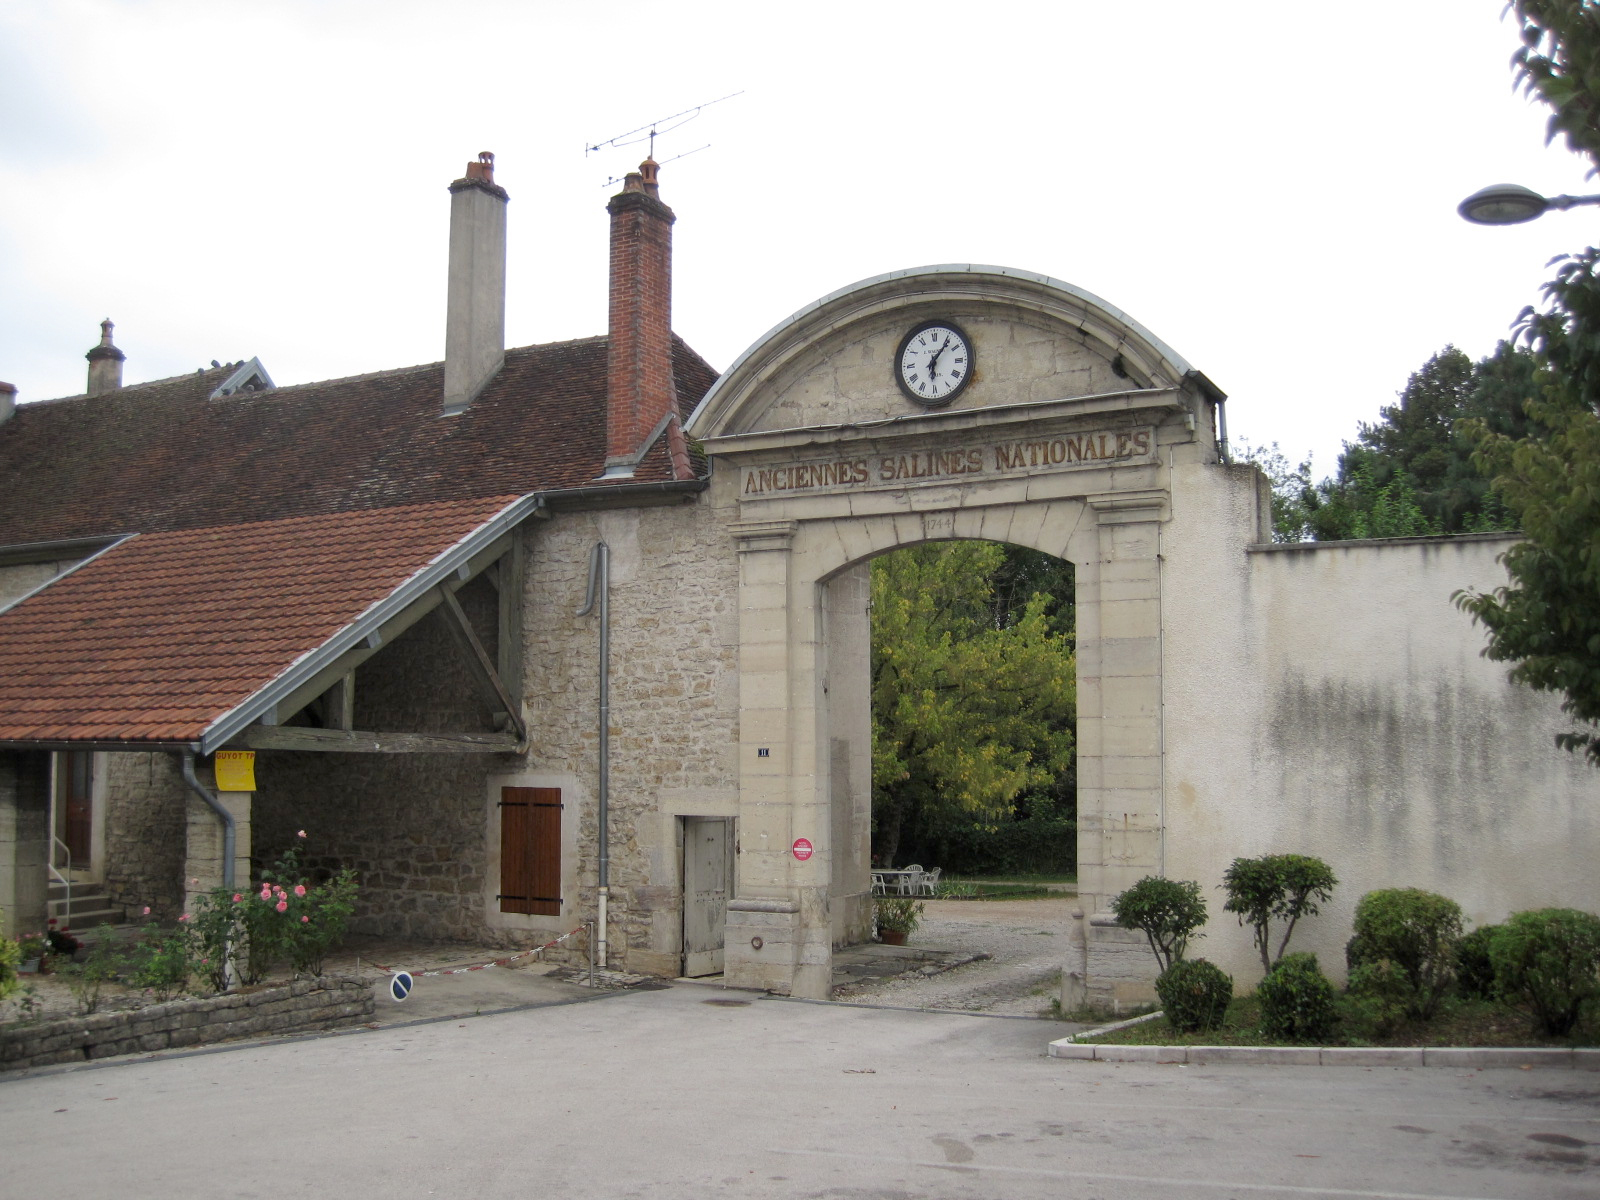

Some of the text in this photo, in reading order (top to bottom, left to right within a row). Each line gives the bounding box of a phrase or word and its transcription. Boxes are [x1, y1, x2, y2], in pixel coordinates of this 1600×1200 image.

[745, 431, 1150, 494] ANCIENNES SALINES NATIONALES
[927, 518, 952, 530] 1744
